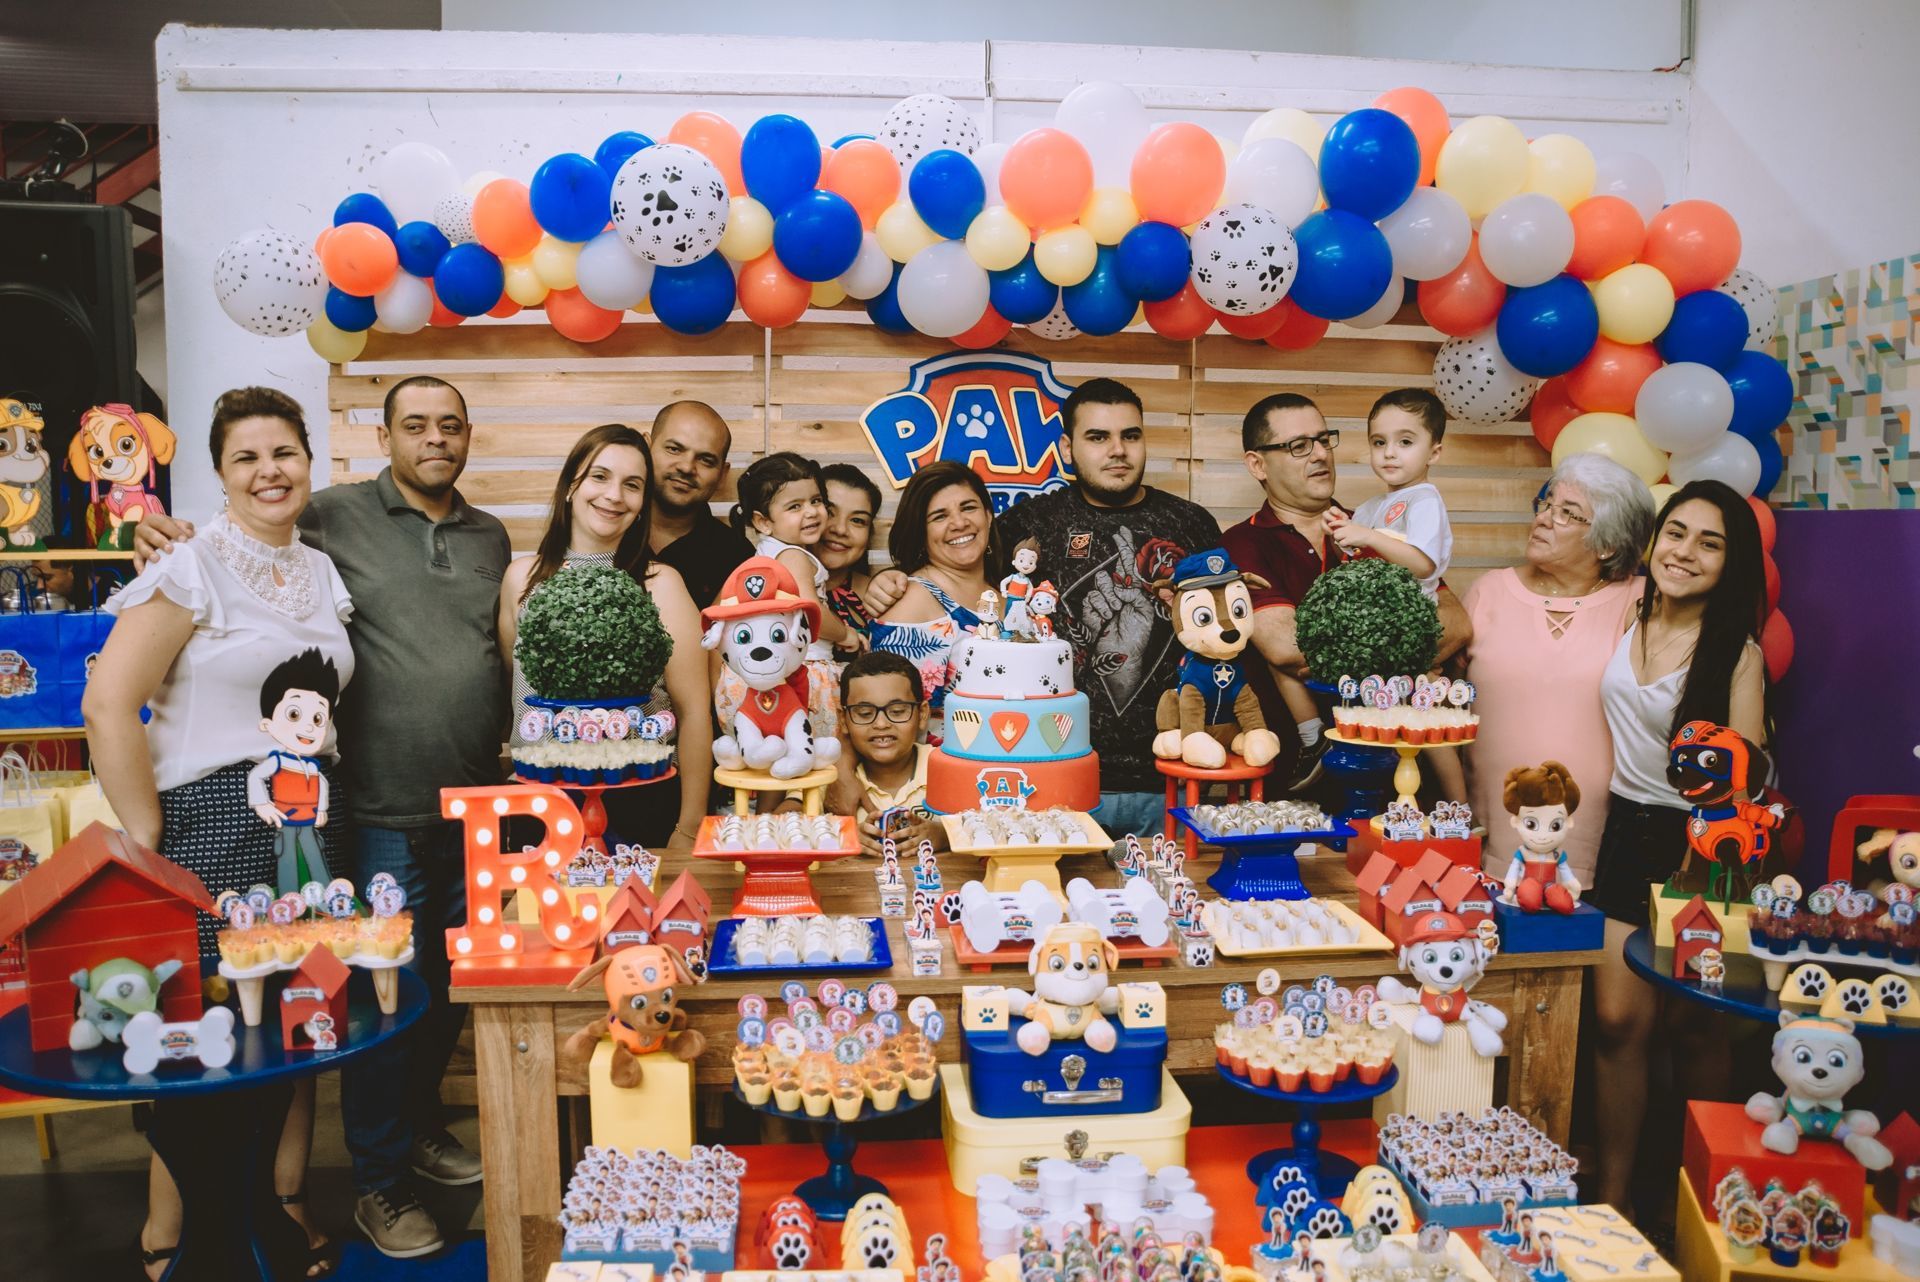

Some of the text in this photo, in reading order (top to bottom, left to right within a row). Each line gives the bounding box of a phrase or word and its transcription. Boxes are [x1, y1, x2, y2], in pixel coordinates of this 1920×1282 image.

[976, 777, 1037, 798] PAW
[986, 797, 1019, 807] PATROL
[440, 784, 601, 960] R
